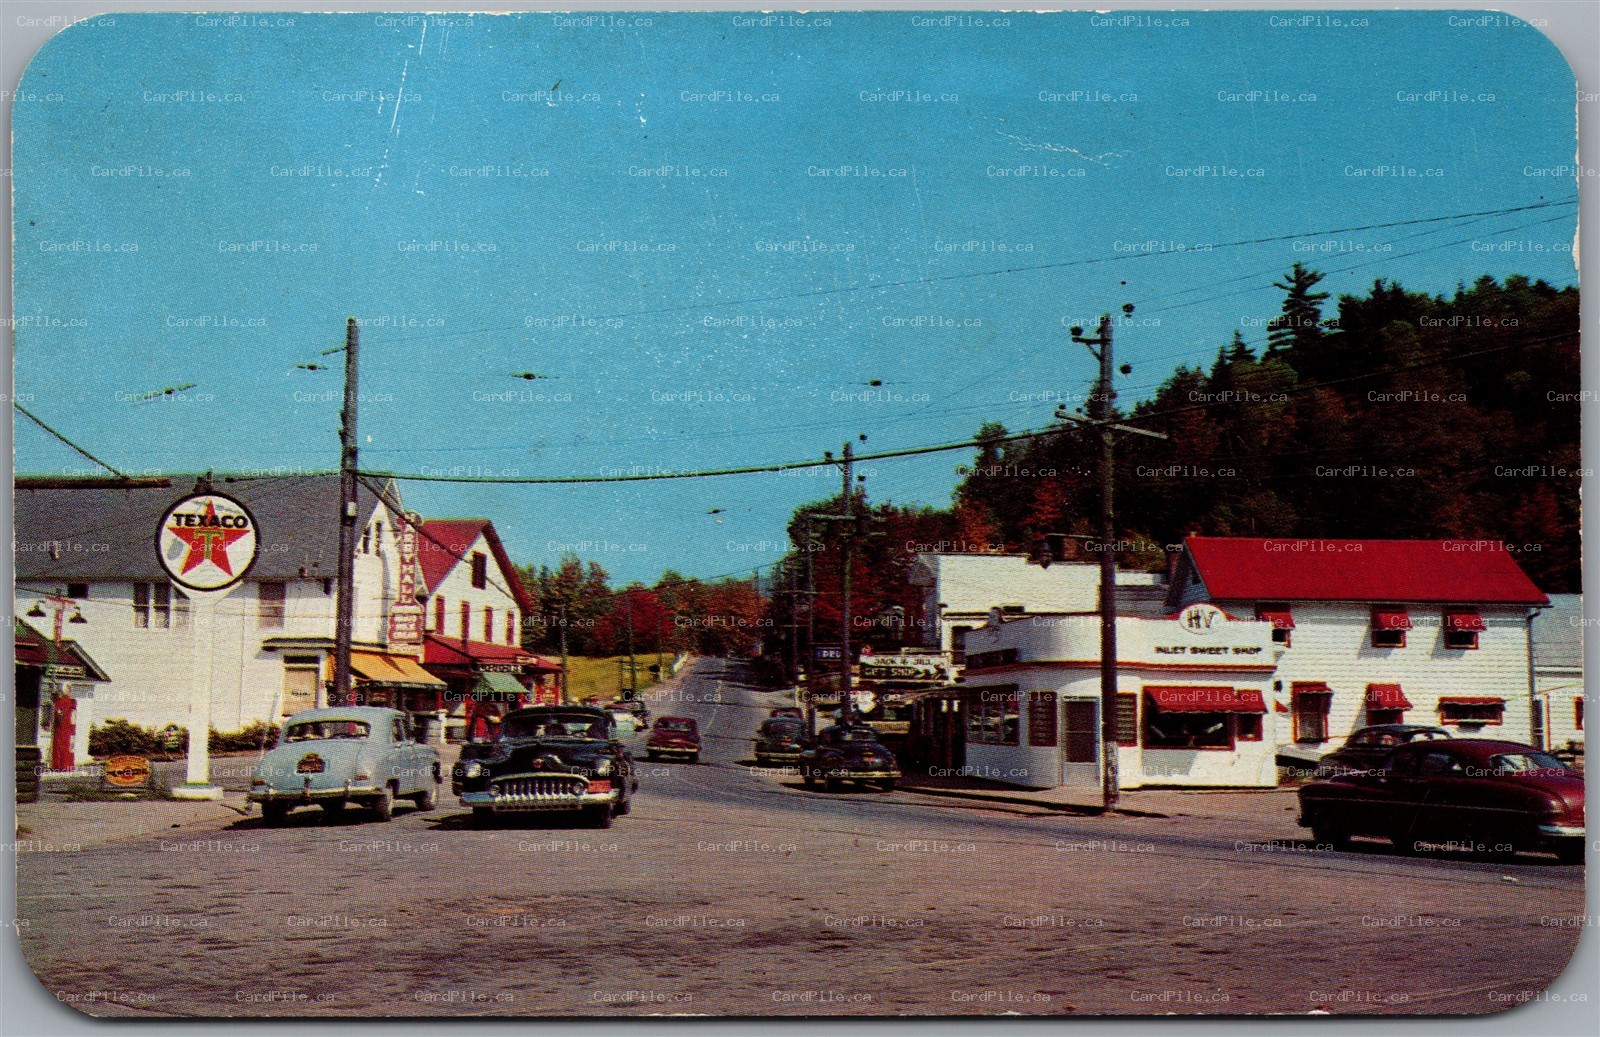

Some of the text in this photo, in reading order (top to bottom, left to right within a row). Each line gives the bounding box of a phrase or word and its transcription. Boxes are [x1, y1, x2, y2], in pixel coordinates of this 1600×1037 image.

[173, 513, 248, 528] TEXACO
[194, 530, 224, 559] T
[1154, 646, 1262, 655] INLET SWEET SHOP
